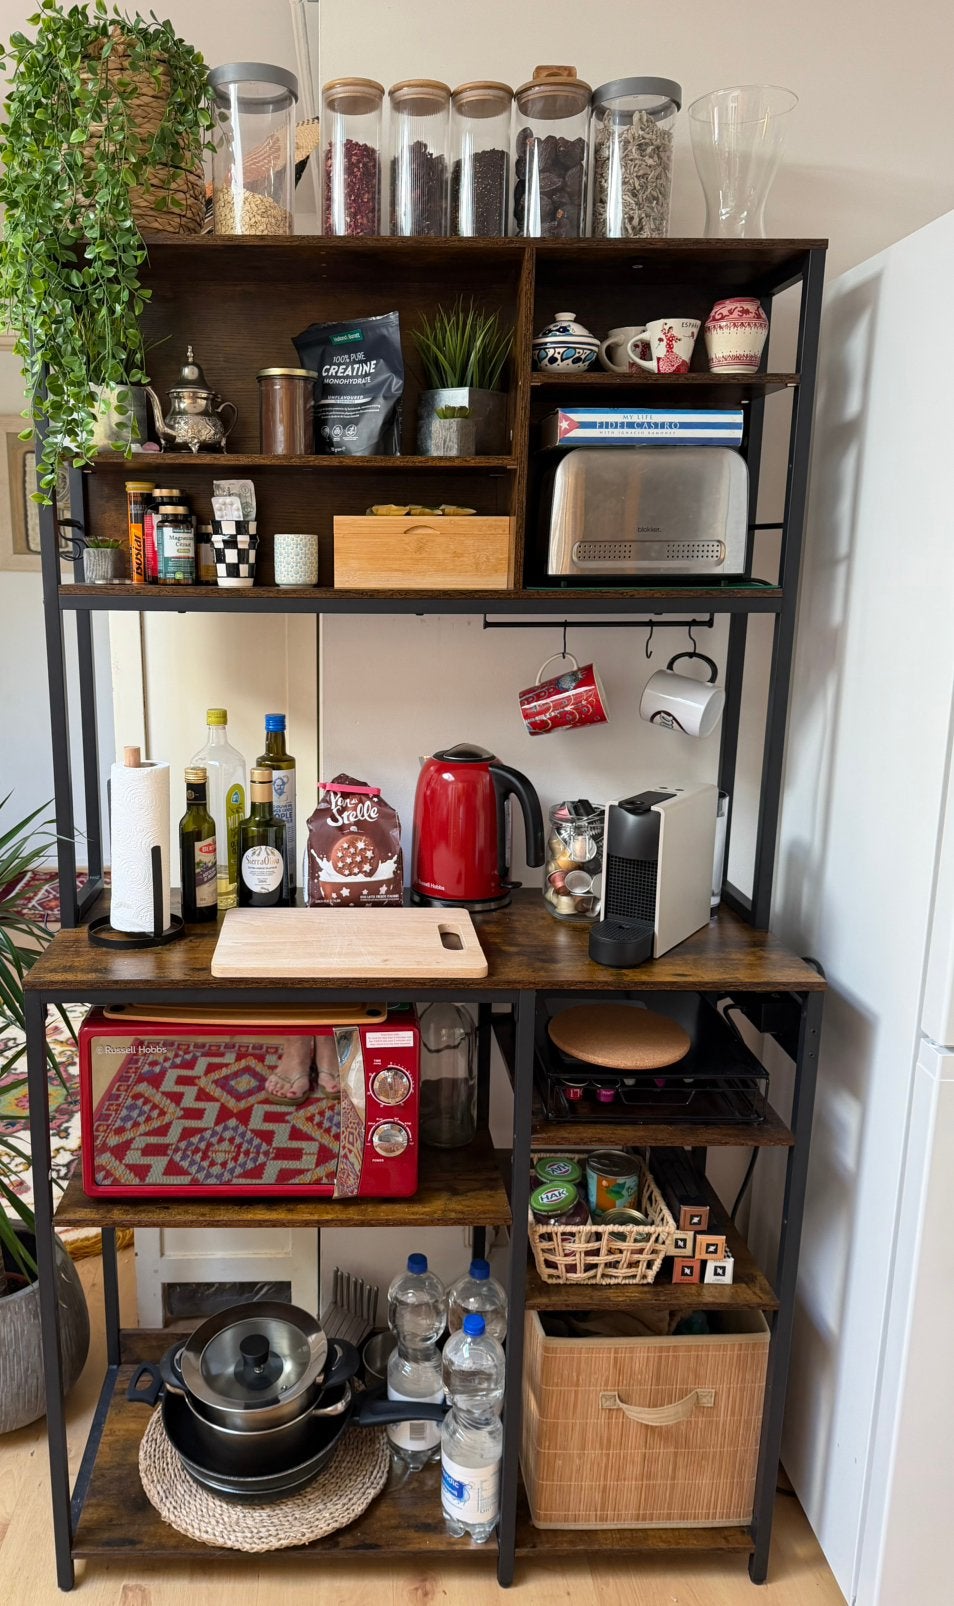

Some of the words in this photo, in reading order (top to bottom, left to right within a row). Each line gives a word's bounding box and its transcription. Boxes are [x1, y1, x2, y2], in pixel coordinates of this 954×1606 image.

[333, 354, 350, 363] 100%
[351, 352, 366, 361] PURE
[322, 360, 377, 377] CREATINE
[324, 376, 371, 385] MONOHYDRATE
[596, 421, 628, 430] FIDEL
[634, 421, 680, 430] CASTRO
[327, 800, 379, 826] Stelle
[105, 1045, 136, 1054] Russell
[138, 1045, 168, 1054] Hobbs
[540, 1189, 567, 1202] HAK
